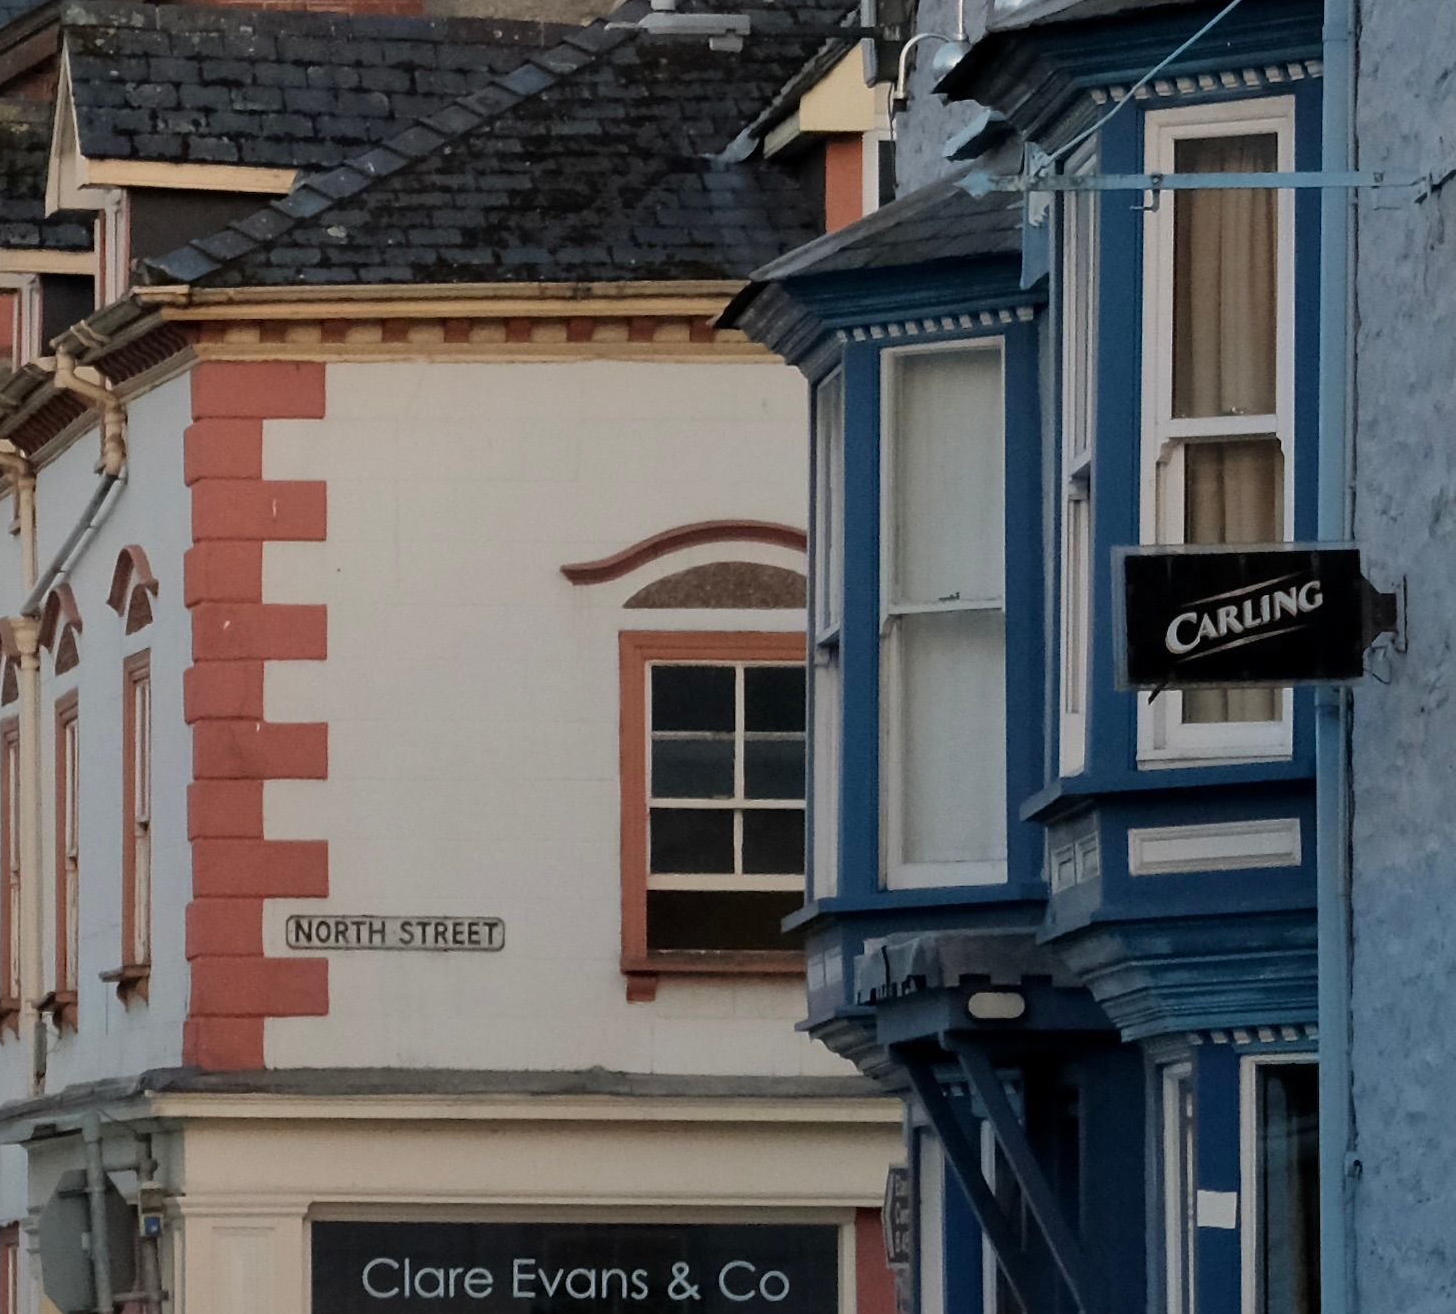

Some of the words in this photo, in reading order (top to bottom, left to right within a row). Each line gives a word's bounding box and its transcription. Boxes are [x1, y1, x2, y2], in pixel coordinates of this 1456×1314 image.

[1165, 580, 1323, 654] CARLING
[294, 920, 386, 944] NORTH
[399, 921, 499, 945] STREET
[362, 1258, 494, 1300] Clare
[512, 1259, 648, 1301] Evans
[667, 1261, 701, 1301] &
[719, 1260, 790, 1302] Co
